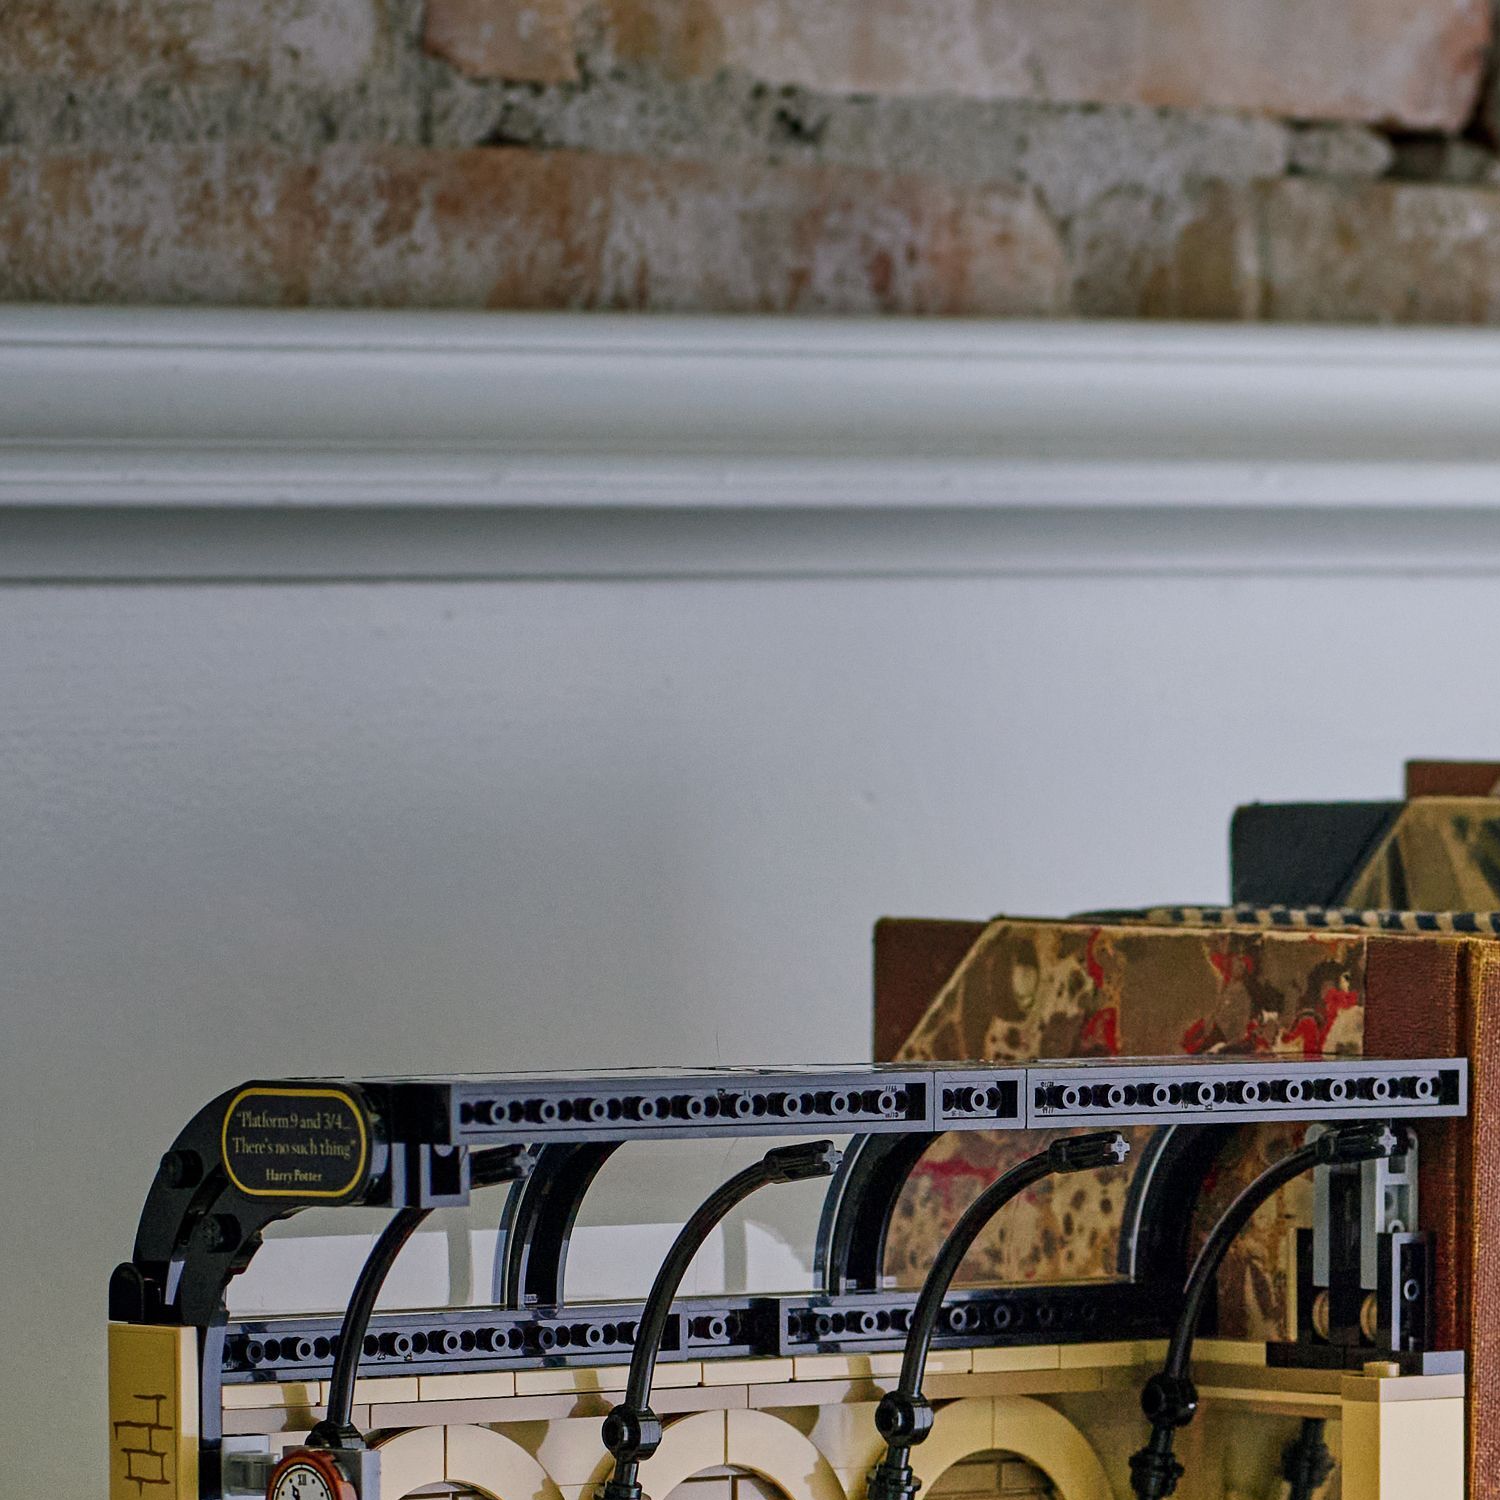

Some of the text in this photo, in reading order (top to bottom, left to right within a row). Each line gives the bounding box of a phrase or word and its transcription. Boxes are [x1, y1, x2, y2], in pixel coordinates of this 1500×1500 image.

[290, 1112, 299, 1127] 9
[300, 1112, 321, 1130] and
[275, 1143, 291, 1154] no
[292, 1138, 318, 1155] such
[266, 1168, 322, 1184] Harry Potter
